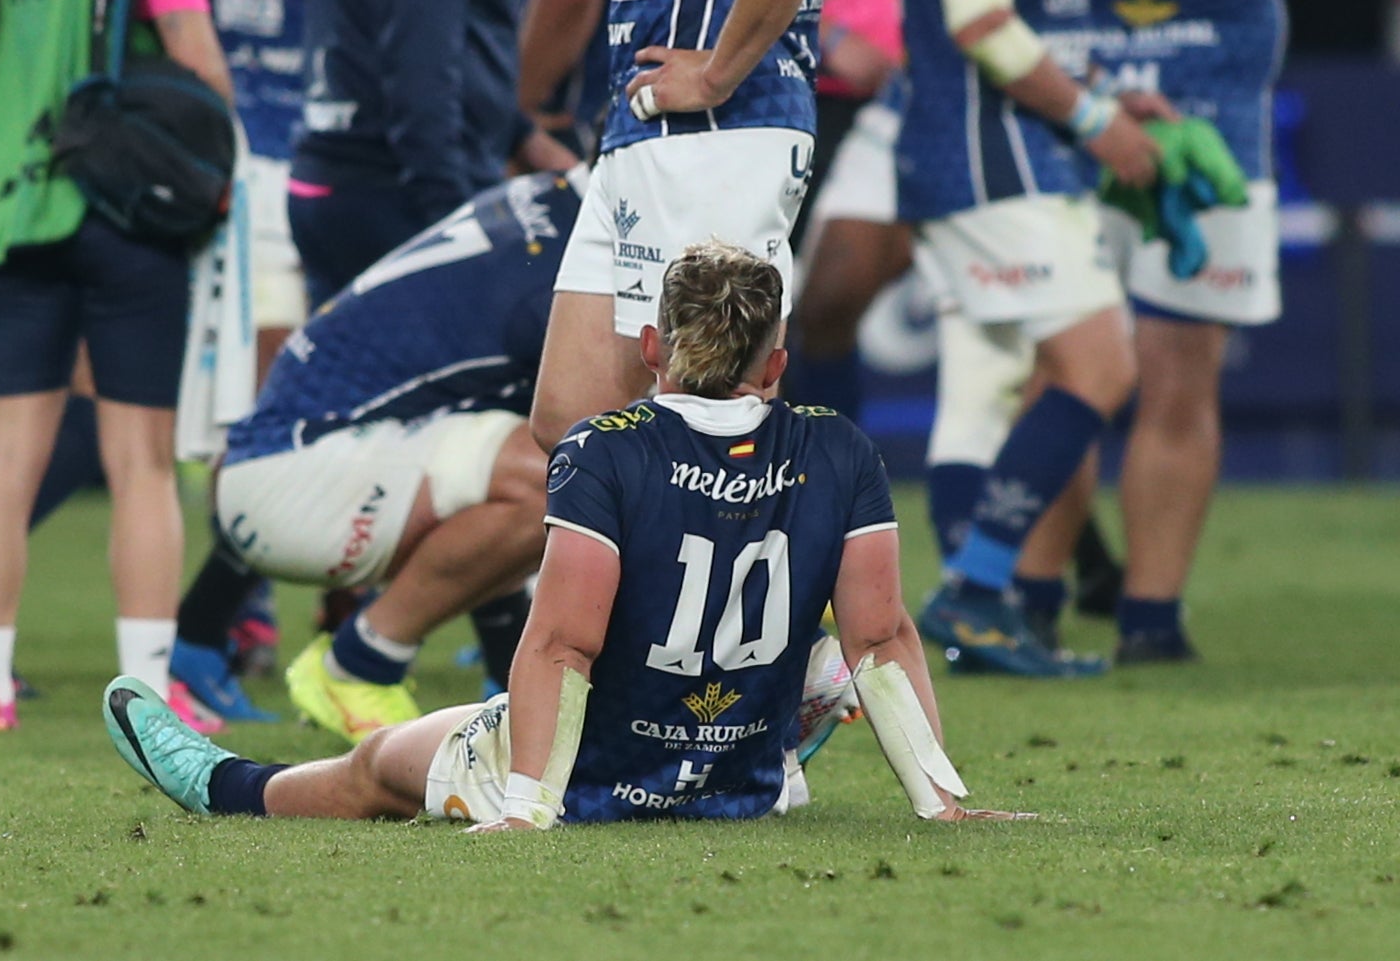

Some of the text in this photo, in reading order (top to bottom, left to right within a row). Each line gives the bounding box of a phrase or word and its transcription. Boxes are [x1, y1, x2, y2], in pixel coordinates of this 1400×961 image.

[618, 243, 665, 263] RURAL
[645, 529, 791, 677] 10
[630, 718, 768, 743] CAJA RURAL
[663, 742, 737, 753] DE ZAMORA
